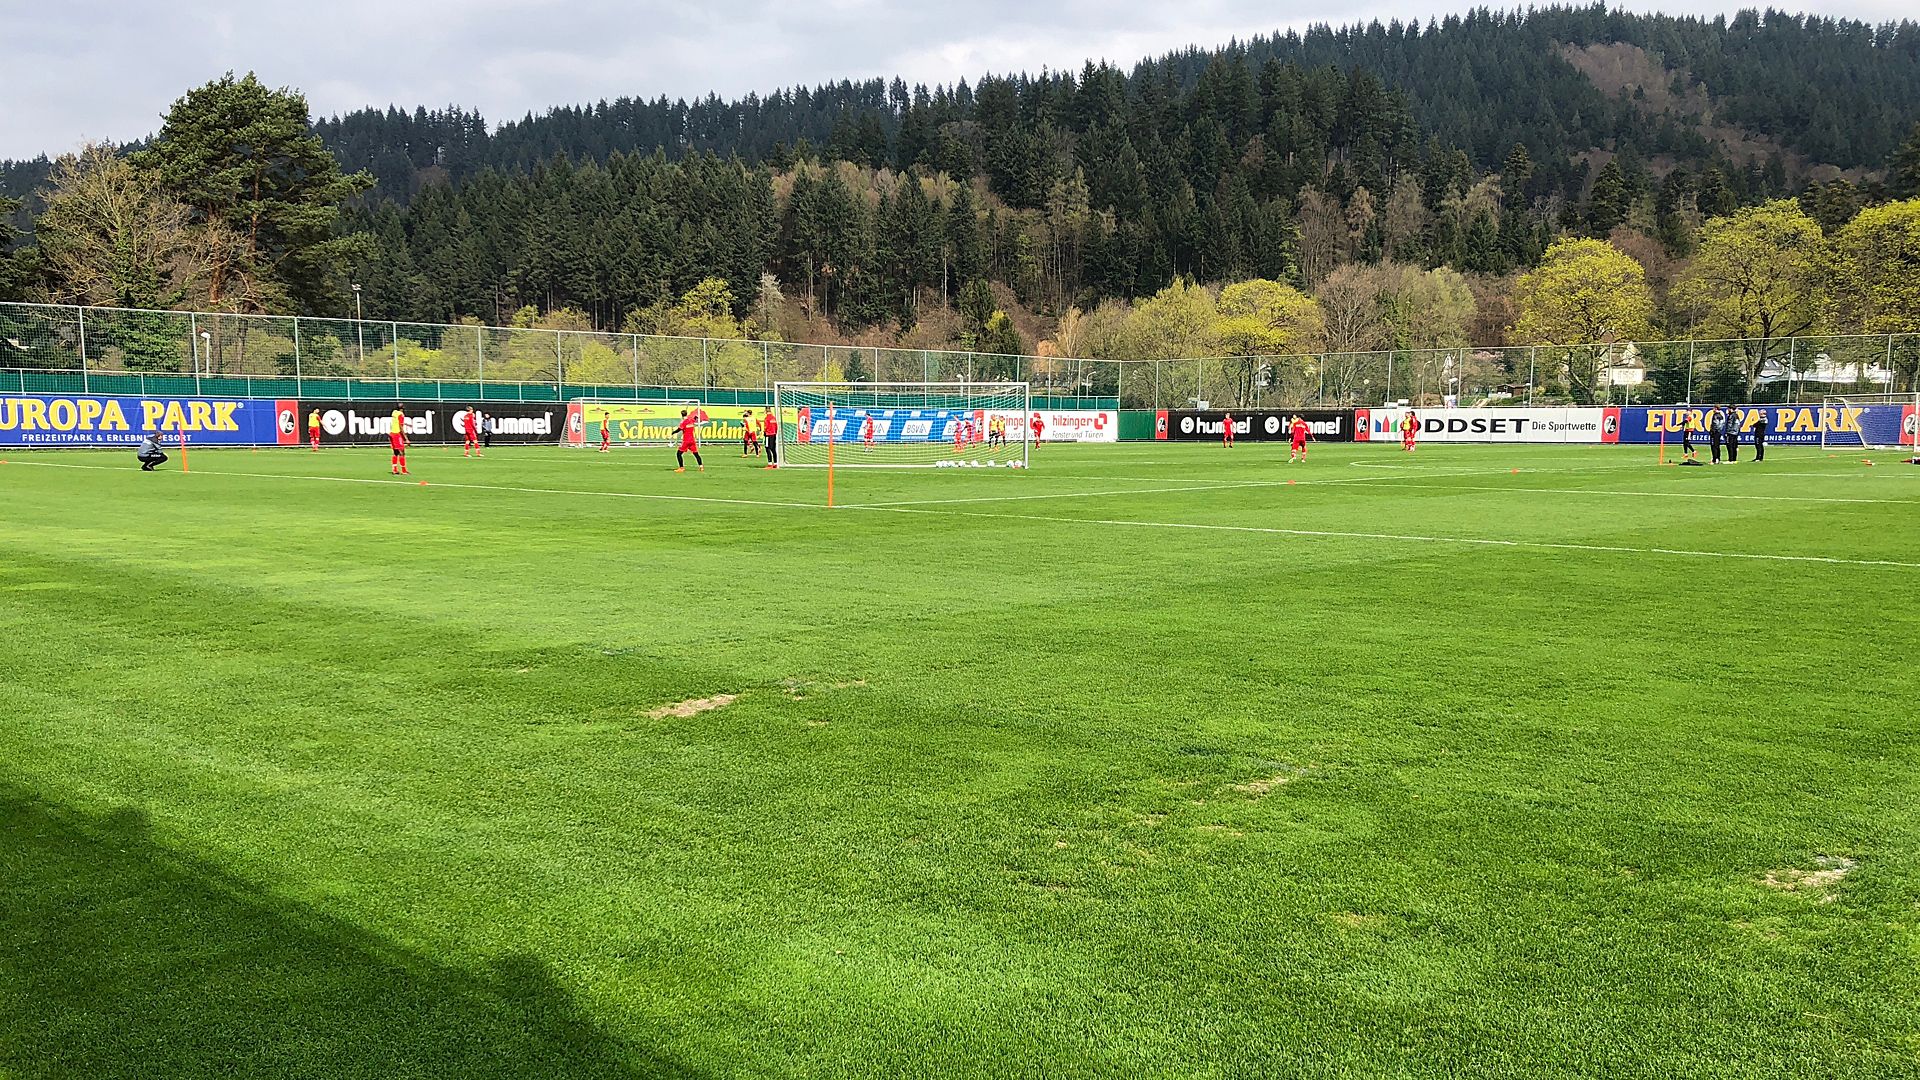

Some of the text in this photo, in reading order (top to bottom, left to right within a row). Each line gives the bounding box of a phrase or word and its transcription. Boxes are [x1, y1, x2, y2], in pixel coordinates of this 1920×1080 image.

[1052, 414, 1093, 430] hilzinger
[1416, 418, 1597, 434] DDSET Die Sportwette
[22, 434, 93, 442] FREIZEITPARK
